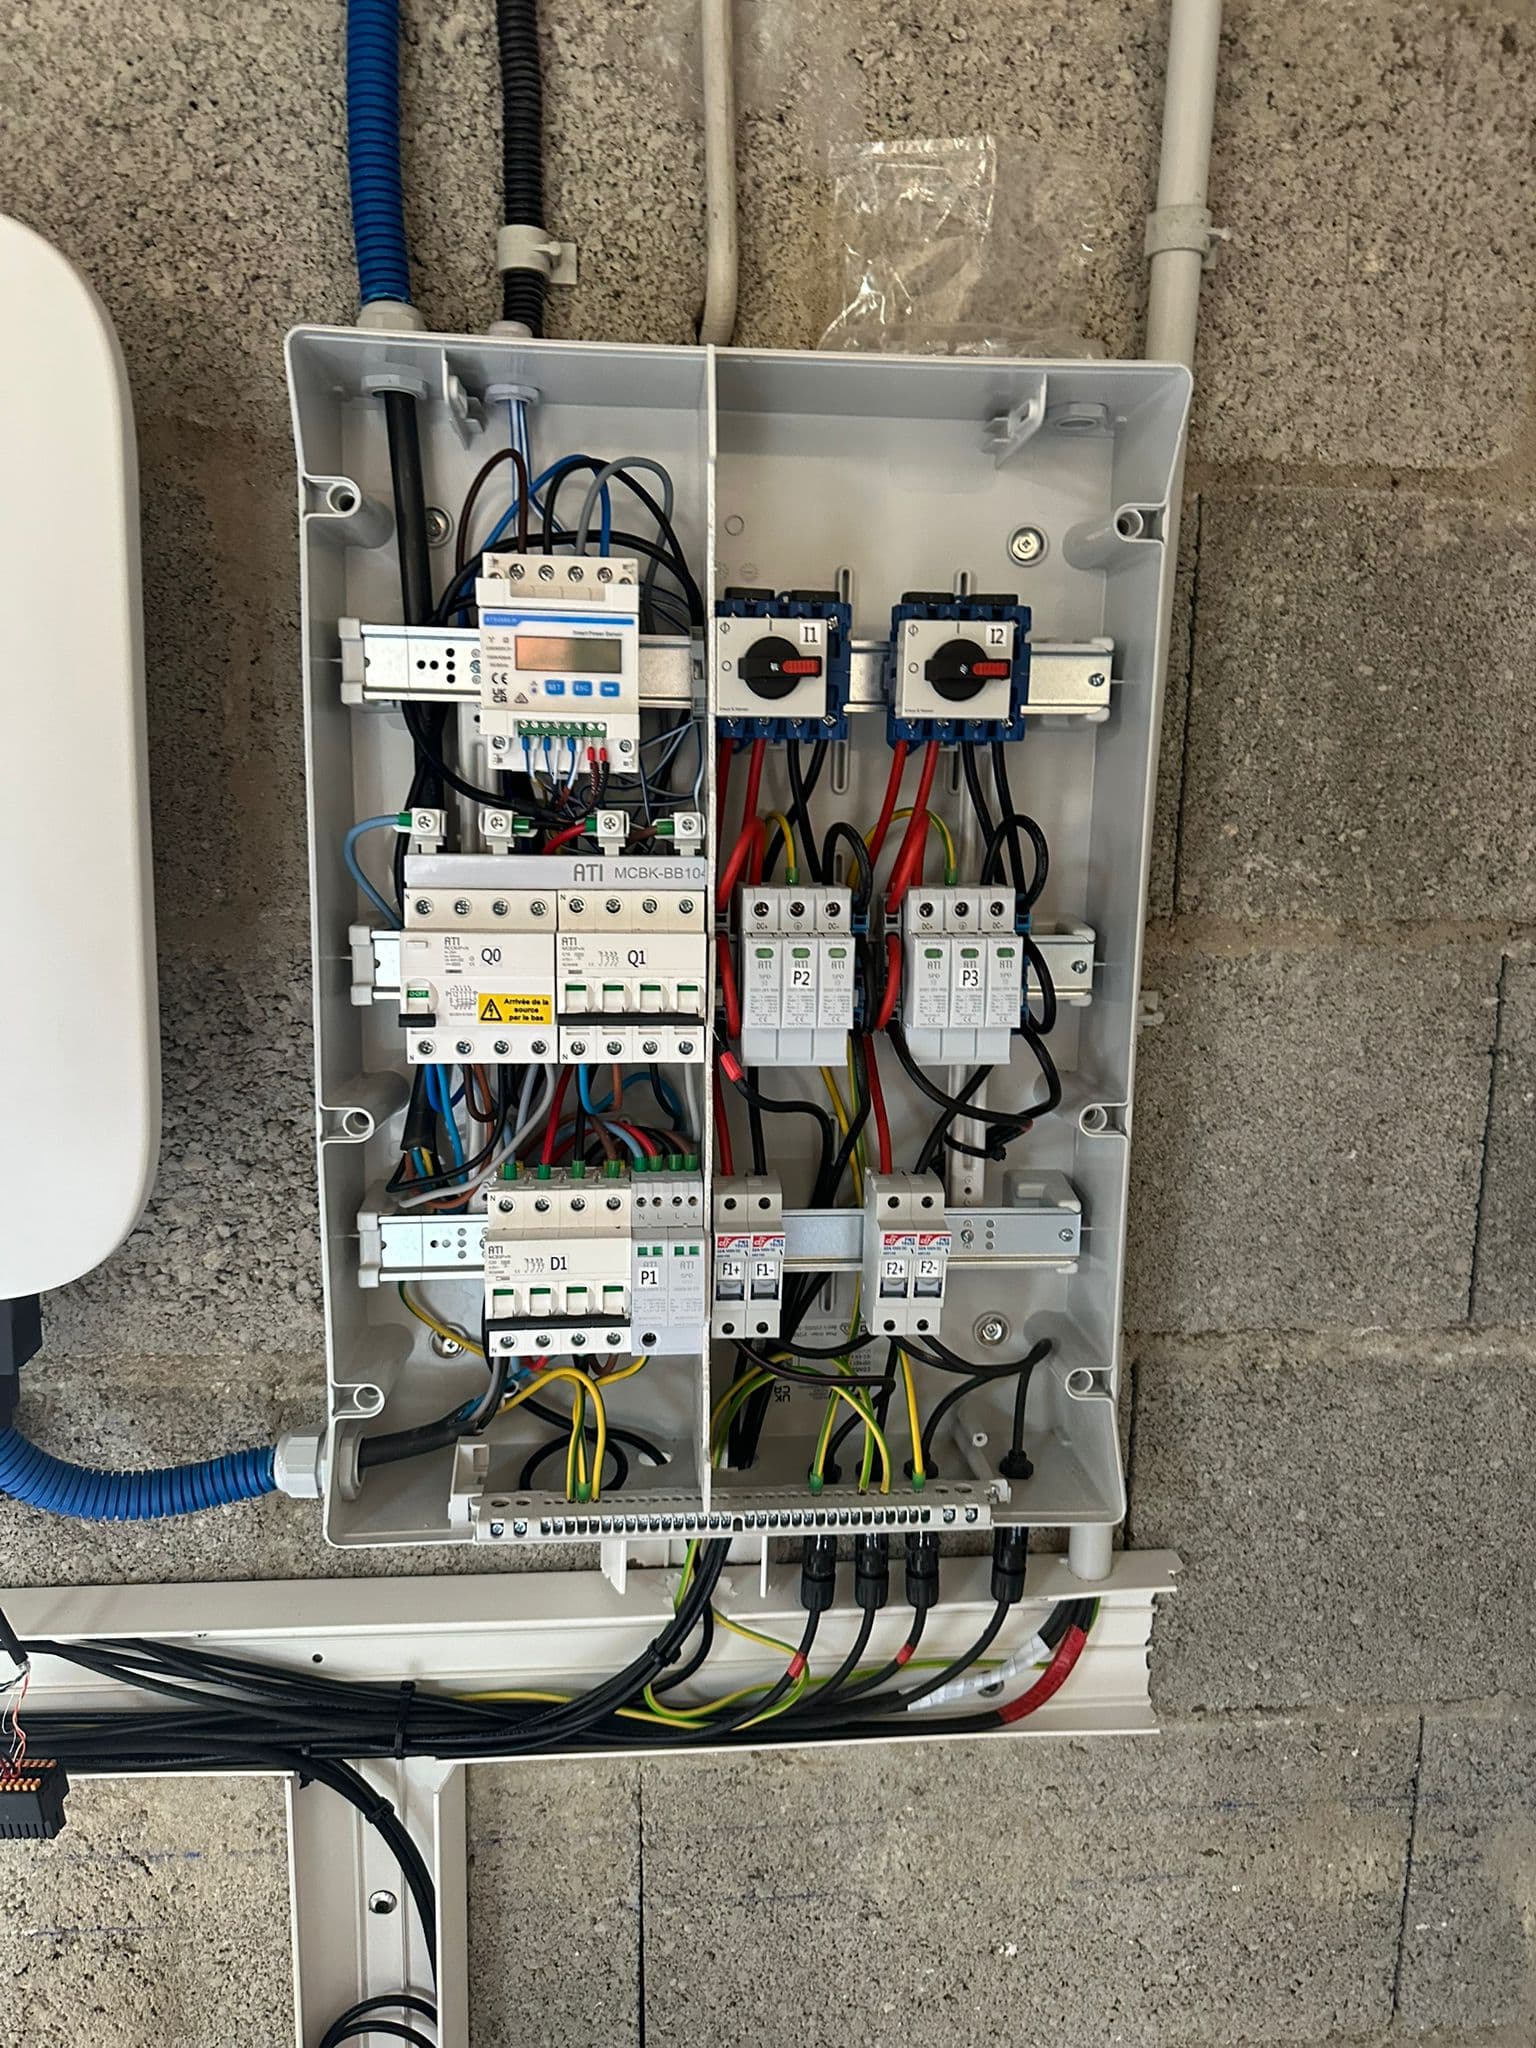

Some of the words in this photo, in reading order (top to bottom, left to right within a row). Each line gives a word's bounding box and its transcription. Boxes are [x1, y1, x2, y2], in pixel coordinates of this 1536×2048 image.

[990, 628, 1005, 645] I2
[573, 863, 604, 882] ATI
[444, 936, 461, 946] ATI
[561, 936, 578, 946] ATI
[481, 947, 502, 966] Q0
[627, 949, 647, 968] Q1
[792, 970, 811, 986] P2
[962, 969, 979, 986] P3
[531, 998, 541, 1006] de
[488, 1245, 504, 1255] ATI
[550, 1255, 568, 1271] D1
[722, 1262, 740, 1276] F1+
[756, 1263, 774, 1276] F1-
[886, 1261, 904, 1275] F2+
[920, 1260, 938, 1274] F2-
[640, 1270, 658, 1285] P1
